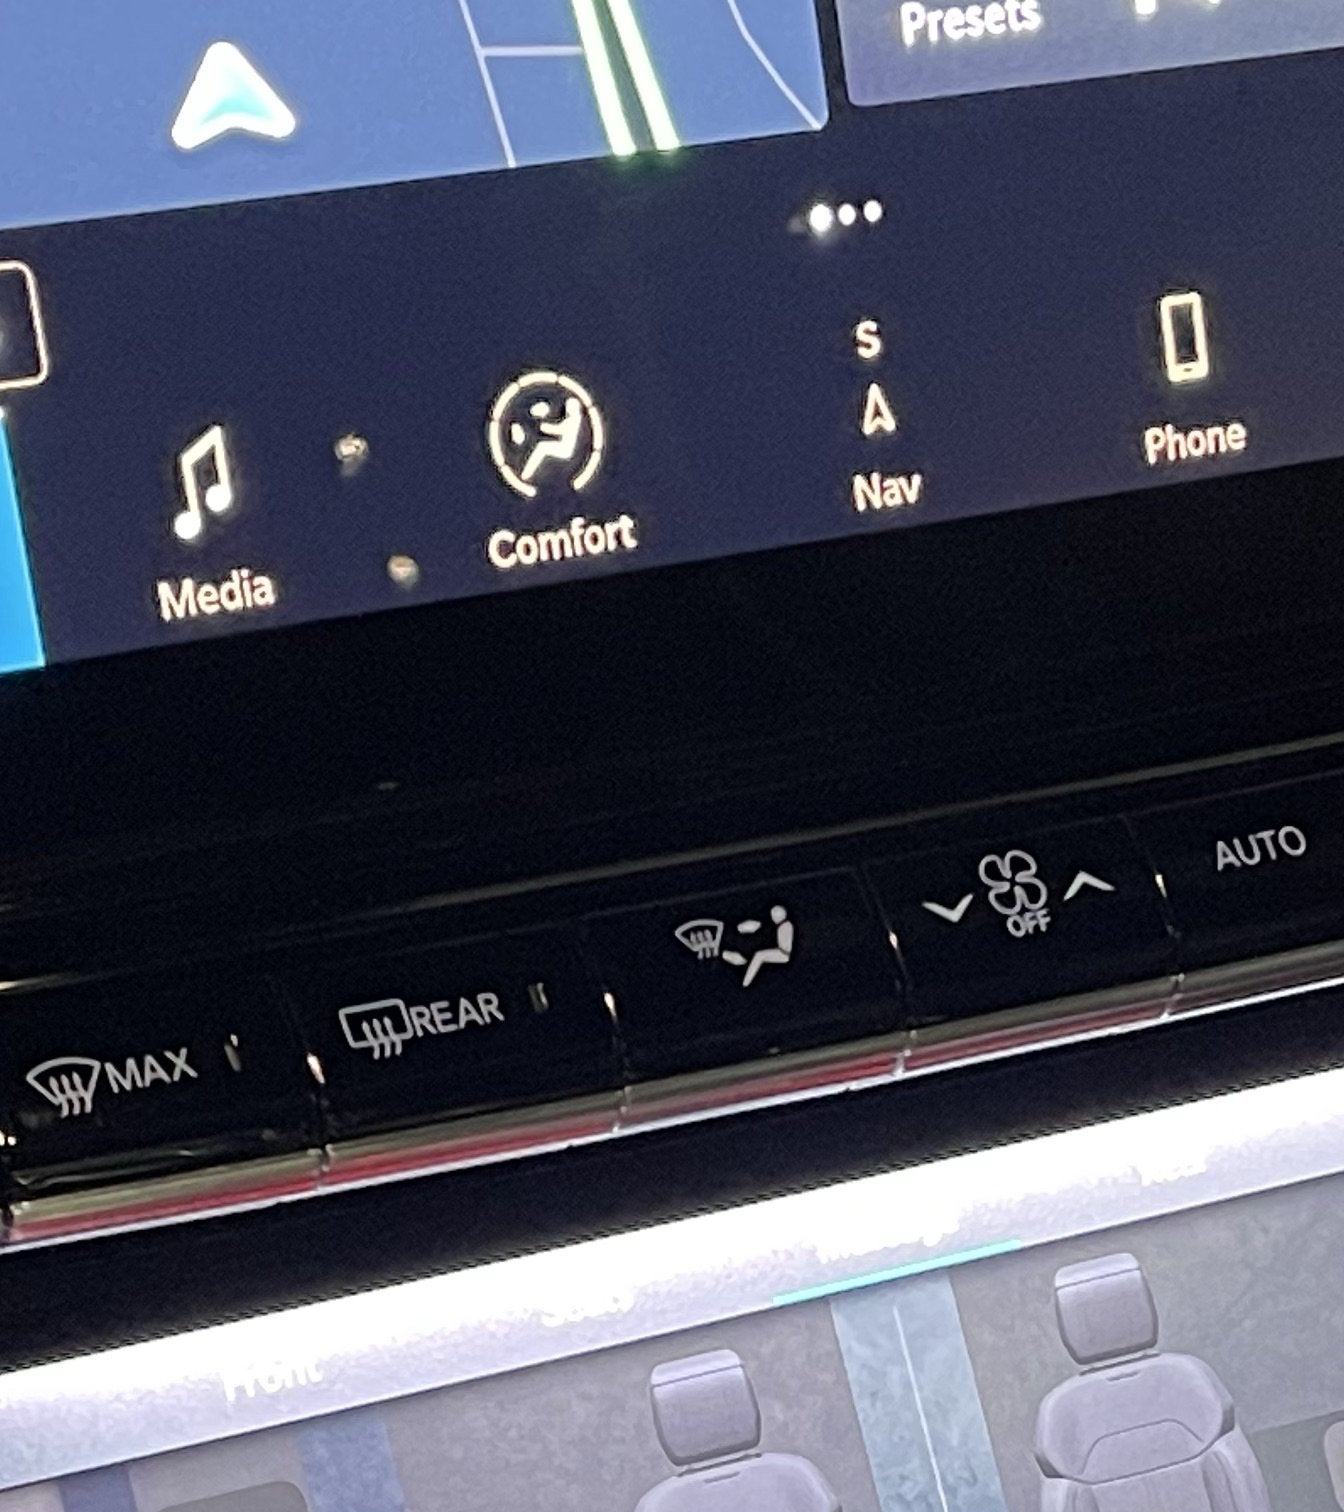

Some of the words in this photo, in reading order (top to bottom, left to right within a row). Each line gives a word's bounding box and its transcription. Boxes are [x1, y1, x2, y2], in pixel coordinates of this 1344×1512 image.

[900, 0, 1043, 48] Presets
[1145, 419, 1247, 465] Phone
[853, 470, 923, 512] Nav
[488, 514, 638, 569] Comfort
[157, 567, 276, 621] Media
[1215, 825, 1308, 872] AUTO
[1006, 908, 1052, 938] OFF
[410, 992, 505, 1037] REAR
[105, 1047, 198, 1095] MAX
